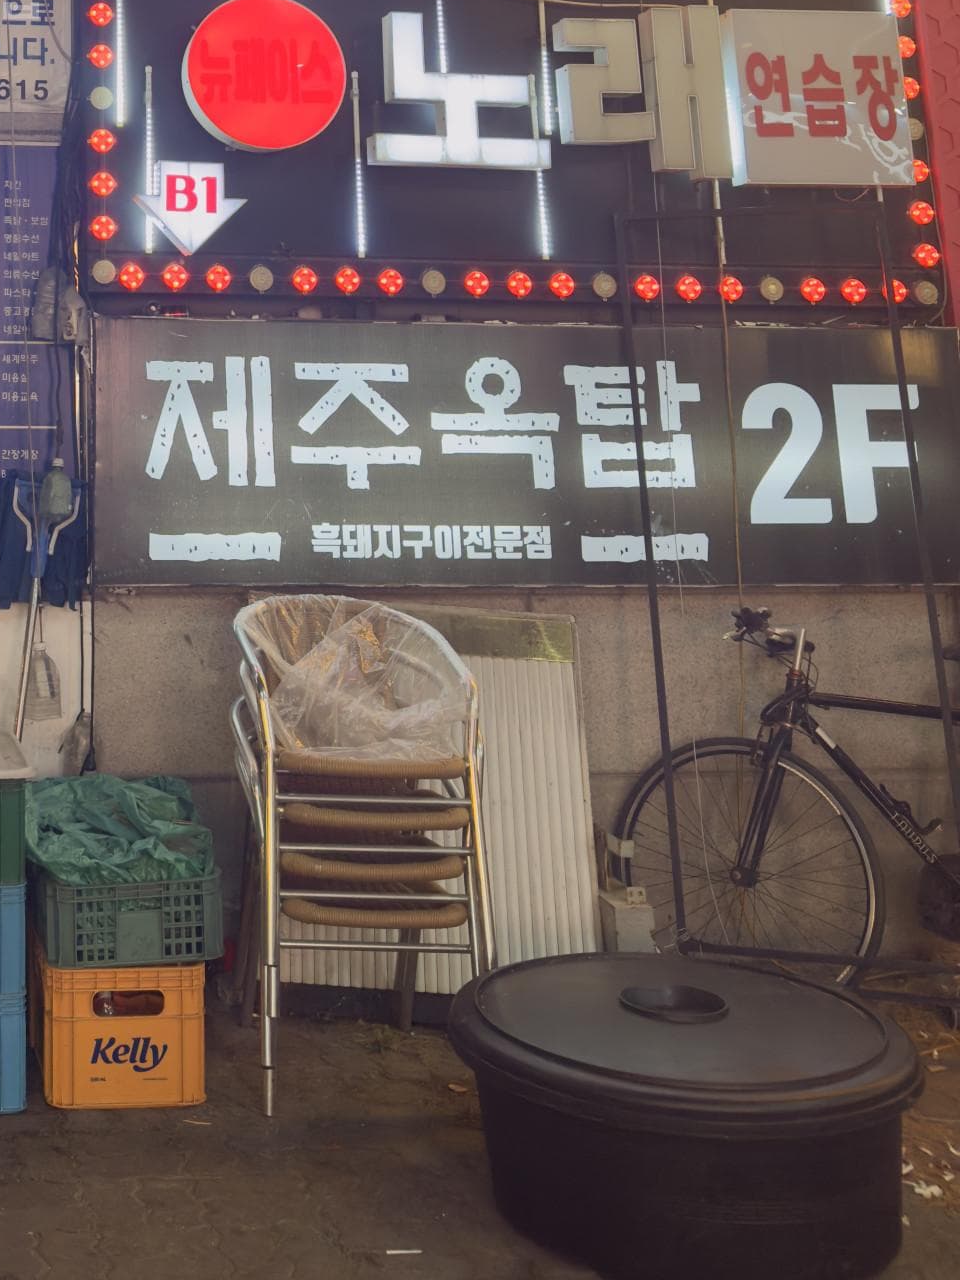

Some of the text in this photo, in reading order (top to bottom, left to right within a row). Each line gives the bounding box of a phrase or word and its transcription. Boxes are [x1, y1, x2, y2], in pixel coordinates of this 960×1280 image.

[194, 39, 335, 106] 뉴페이스
[367, 4, 899, 181] 노래 연습장
[164, 173, 219, 215] B1
[3, 269, 40, 280] 의류수선
[144, 355, 701, 491] 제주옥탑
[741, 382, 921, 525] 2F
[311, 522, 553, 560] 흑돼지구이전문점
[90, 1037, 168, 1072] Kelly
